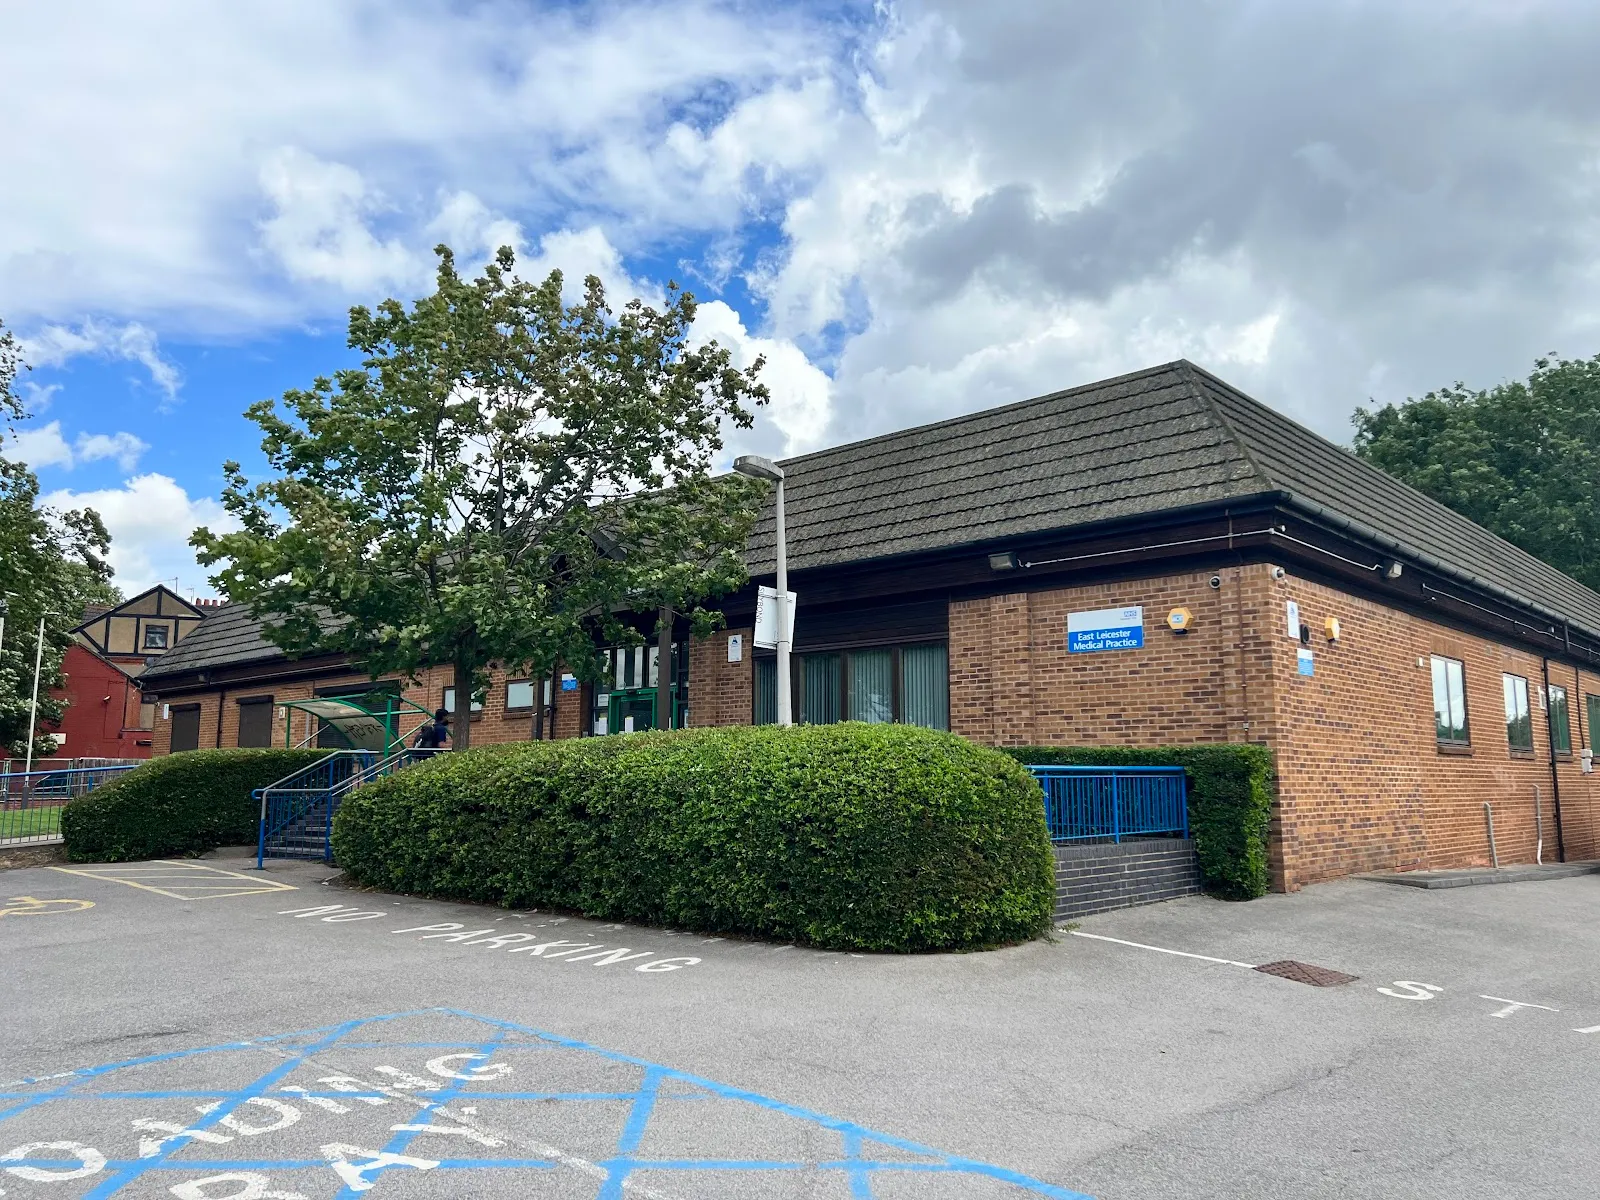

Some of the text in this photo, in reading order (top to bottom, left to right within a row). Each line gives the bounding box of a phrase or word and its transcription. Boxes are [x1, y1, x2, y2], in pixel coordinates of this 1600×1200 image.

[1073, 638, 1137, 650] Medical Practice
[1078, 630, 1131, 641] East Leicester
[277, 904, 702, 973] NO PARKING
[1377, 980, 1600, 1033] ST
[0, 1053, 513, 1195] OADING
